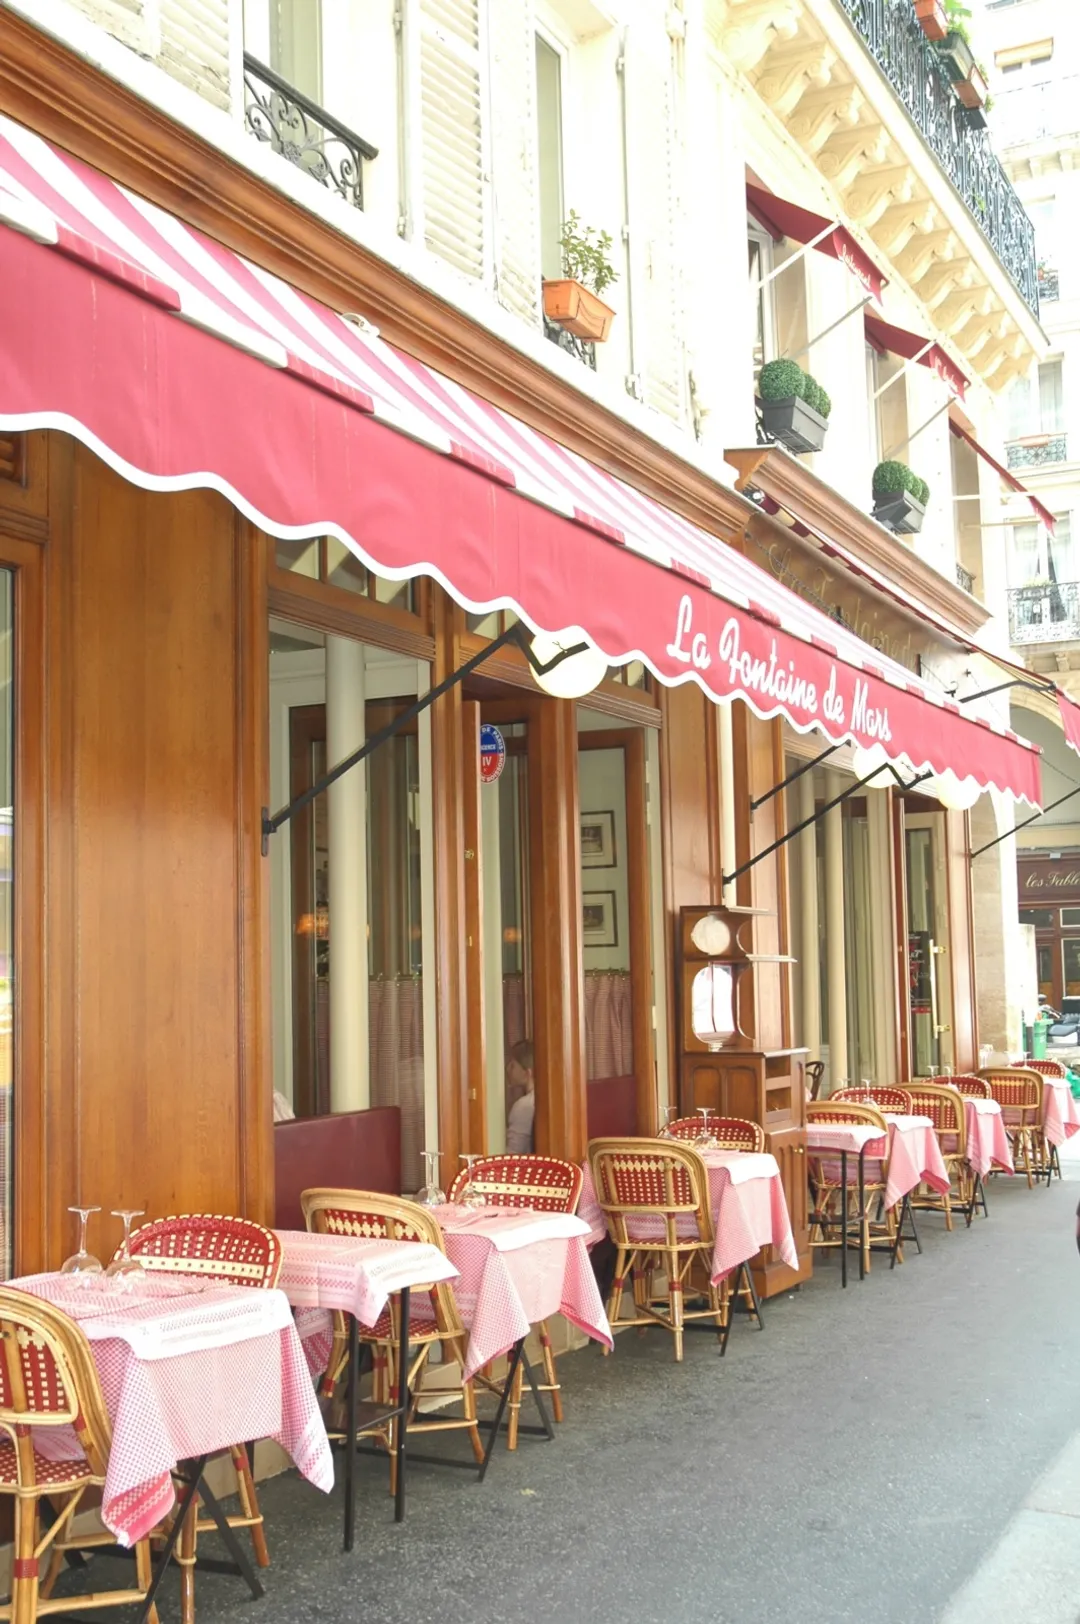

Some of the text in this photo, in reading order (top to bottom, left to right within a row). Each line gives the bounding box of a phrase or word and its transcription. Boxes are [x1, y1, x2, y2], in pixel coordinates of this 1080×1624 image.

[666, 594, 892, 742] La Fontaine de Mars
[482, 756, 492, 767] IV
